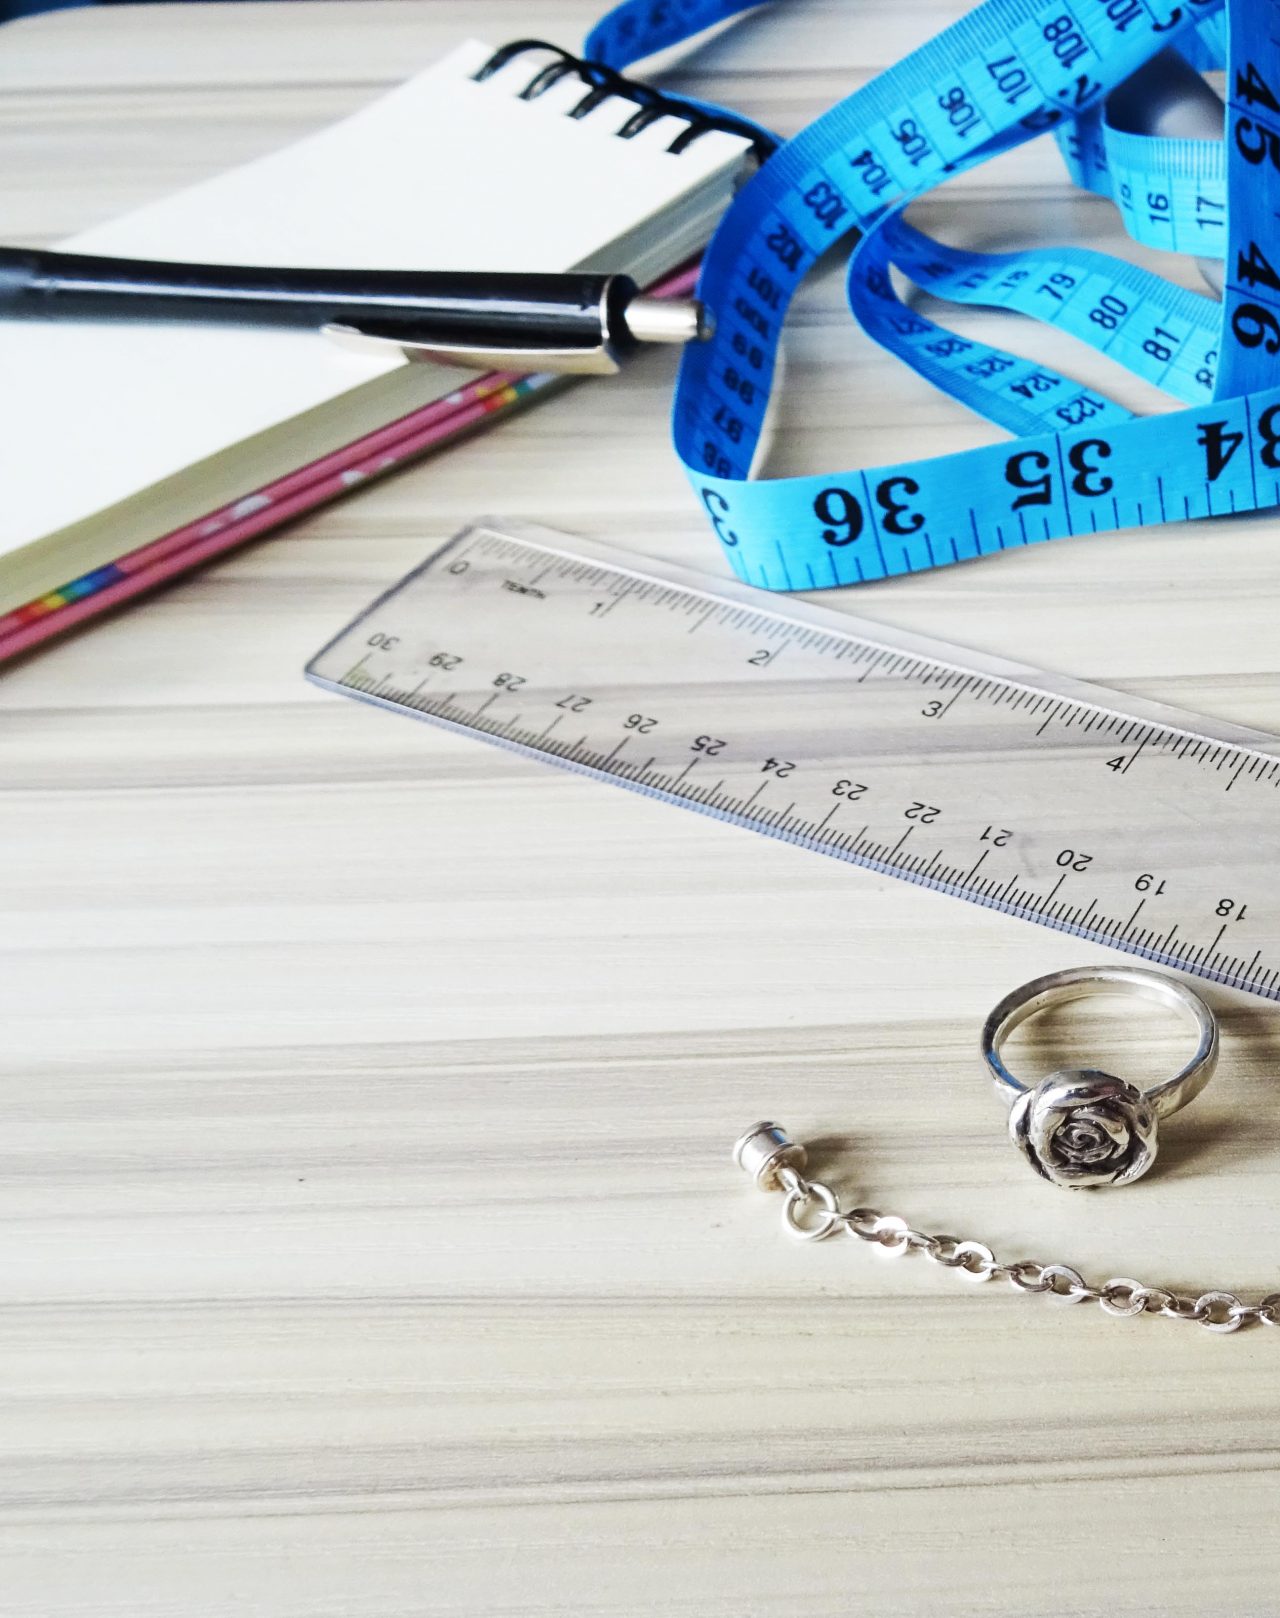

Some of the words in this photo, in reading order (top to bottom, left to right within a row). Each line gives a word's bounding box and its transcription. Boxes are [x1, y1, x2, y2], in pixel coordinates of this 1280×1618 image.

[1100, 0, 1143, 32] 10
[1043, 15, 1089, 69] 108
[987, 55, 1033, 105] 107
[938, 87, 981, 138] 106
[890, 118, 933, 167] 105
[850, 149, 893, 196] 104
[803, 181, 849, 230] 103
[1148, 192, 1171, 226] 16
[1195, 195, 1225, 230] 17
[766, 223, 804, 273] 102
[1037, 272, 1077, 302] 79
[1089, 294, 1128, 330] 80
[1142, 326, 1181, 362] 81
[1010, 372, 1061, 399] 124
[1055, 395, 1106, 425] 123
[1004, 438, 1114, 513] 35
[813, 475, 927, 548] 36
[450, 561, 471, 576] 0
[748, 649, 770, 666] 2
[921, 700, 943, 718] 3
[1105, 755, 1127, 772] 4
[367, 632, 401, 651] 30
[428, 652, 464, 672] 29
[492, 672, 527, 692] 28
[554, 694, 593, 713] 27
[623, 713, 659, 735] 26
[690, 735, 728, 757] 25
[760, 757, 797, 779] 24
[831, 779, 869, 801] 23
[904, 801, 942, 824] 22
[979, 825, 1014, 847] 21
[1056, 849, 1093, 872] 20
[1134, 874, 1167, 896] 19
[1215, 899, 1248, 922] 18
